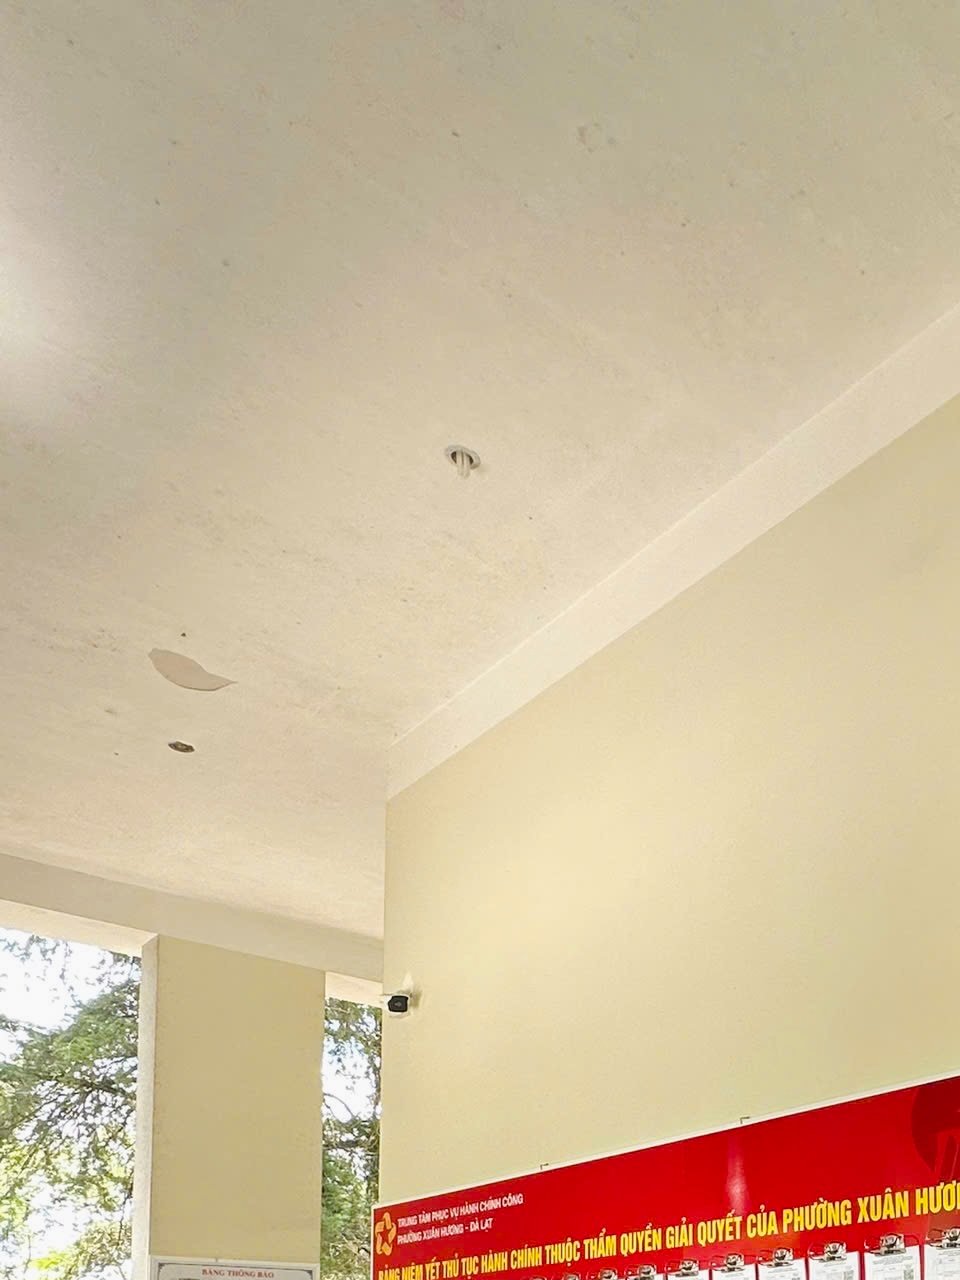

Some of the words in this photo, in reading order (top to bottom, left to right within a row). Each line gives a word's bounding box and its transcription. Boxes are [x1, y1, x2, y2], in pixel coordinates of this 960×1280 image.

[397, 1215, 418, 1228] TRUNG
[431, 1208, 449, 1224] PHỤC
[449, 1206, 460, 1221] VỤ
[479, 1195, 502, 1211] CHÍNH
[501, 1192, 524, 1207] CÔNG
[422, 1226, 440, 1240] XUÂN
[469, 1218, 481, 1233] ĐÀ
[480, 1217, 494, 1233] LẠT
[425, 1256, 440, 1280] YẾT
[442, 1252, 459, 1279] THỦ
[461, 1256, 480, 1280] TỤC
[481, 1249, 508, 1274] HÀNH
[510, 1244, 543, 1270] CHÍNH
[544, 1237, 581, 1267] THUỘC
[583, 1227, 617, 1260] THẨM
[620, 1222, 662, 1258] QUYỀN
[665, 1216, 694, 1249] GIẢI
[697, 1208, 743, 1247] QUYẾT
[746, 1204, 779, 1240] CỦA
[783, 1197, 852, 1235] PHƯỜNG
[857, 1186, 910, 1225] XUÂN
